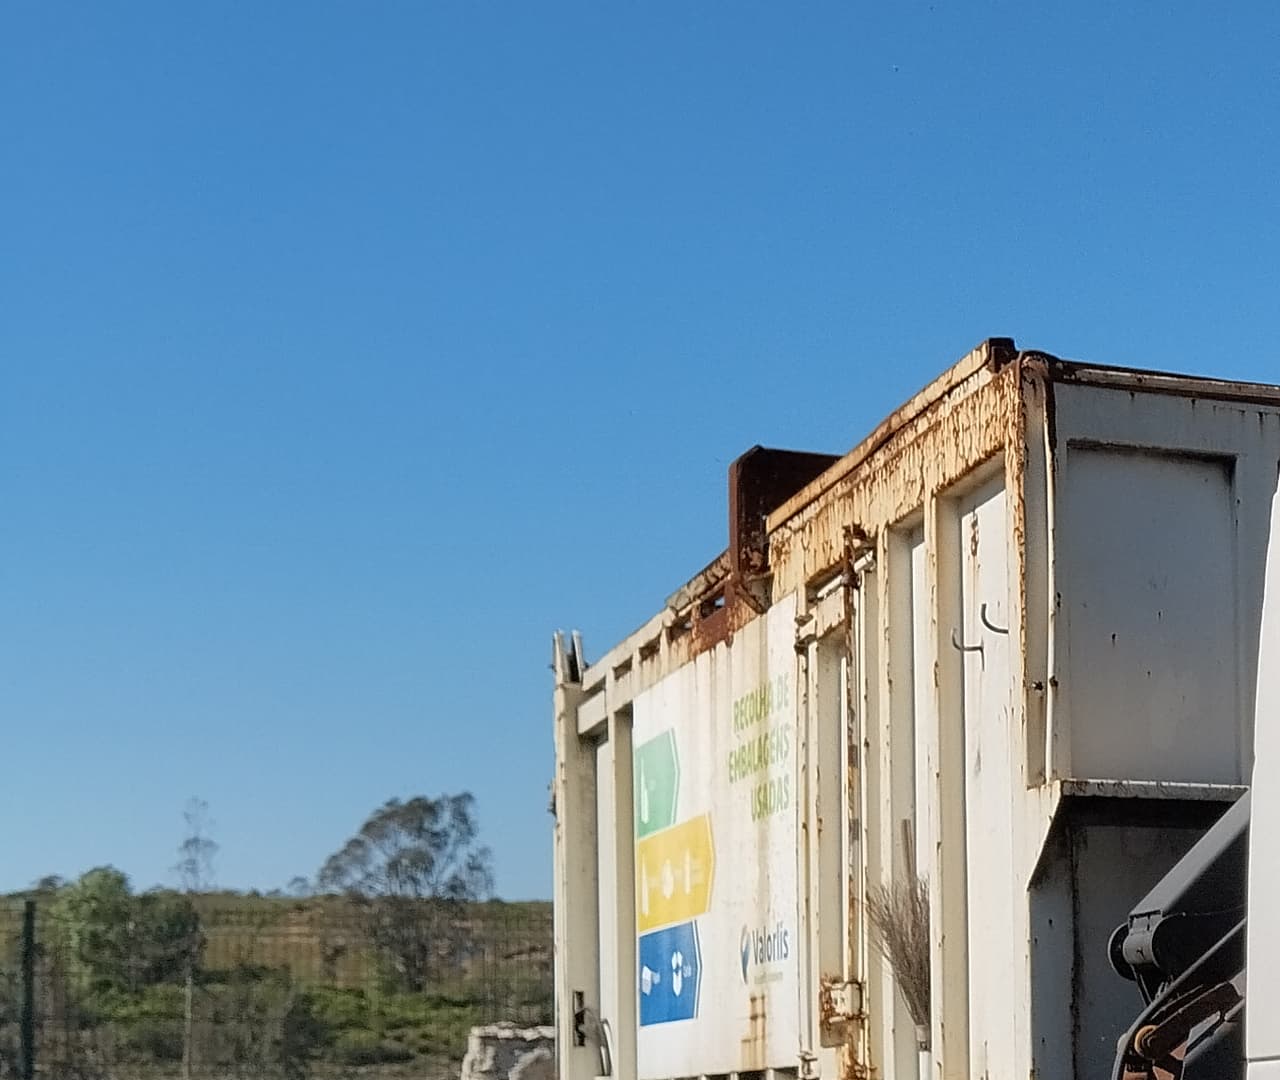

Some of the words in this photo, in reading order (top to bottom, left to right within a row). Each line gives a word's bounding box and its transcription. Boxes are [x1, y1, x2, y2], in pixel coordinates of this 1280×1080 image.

[734, 680, 774, 733] RECOLHA
[777, 671, 789, 711] DE
[729, 723, 790, 784] EMBALAGENS
[751, 773, 789, 822] USADAS
[752, 920, 788, 965] Valorlis
